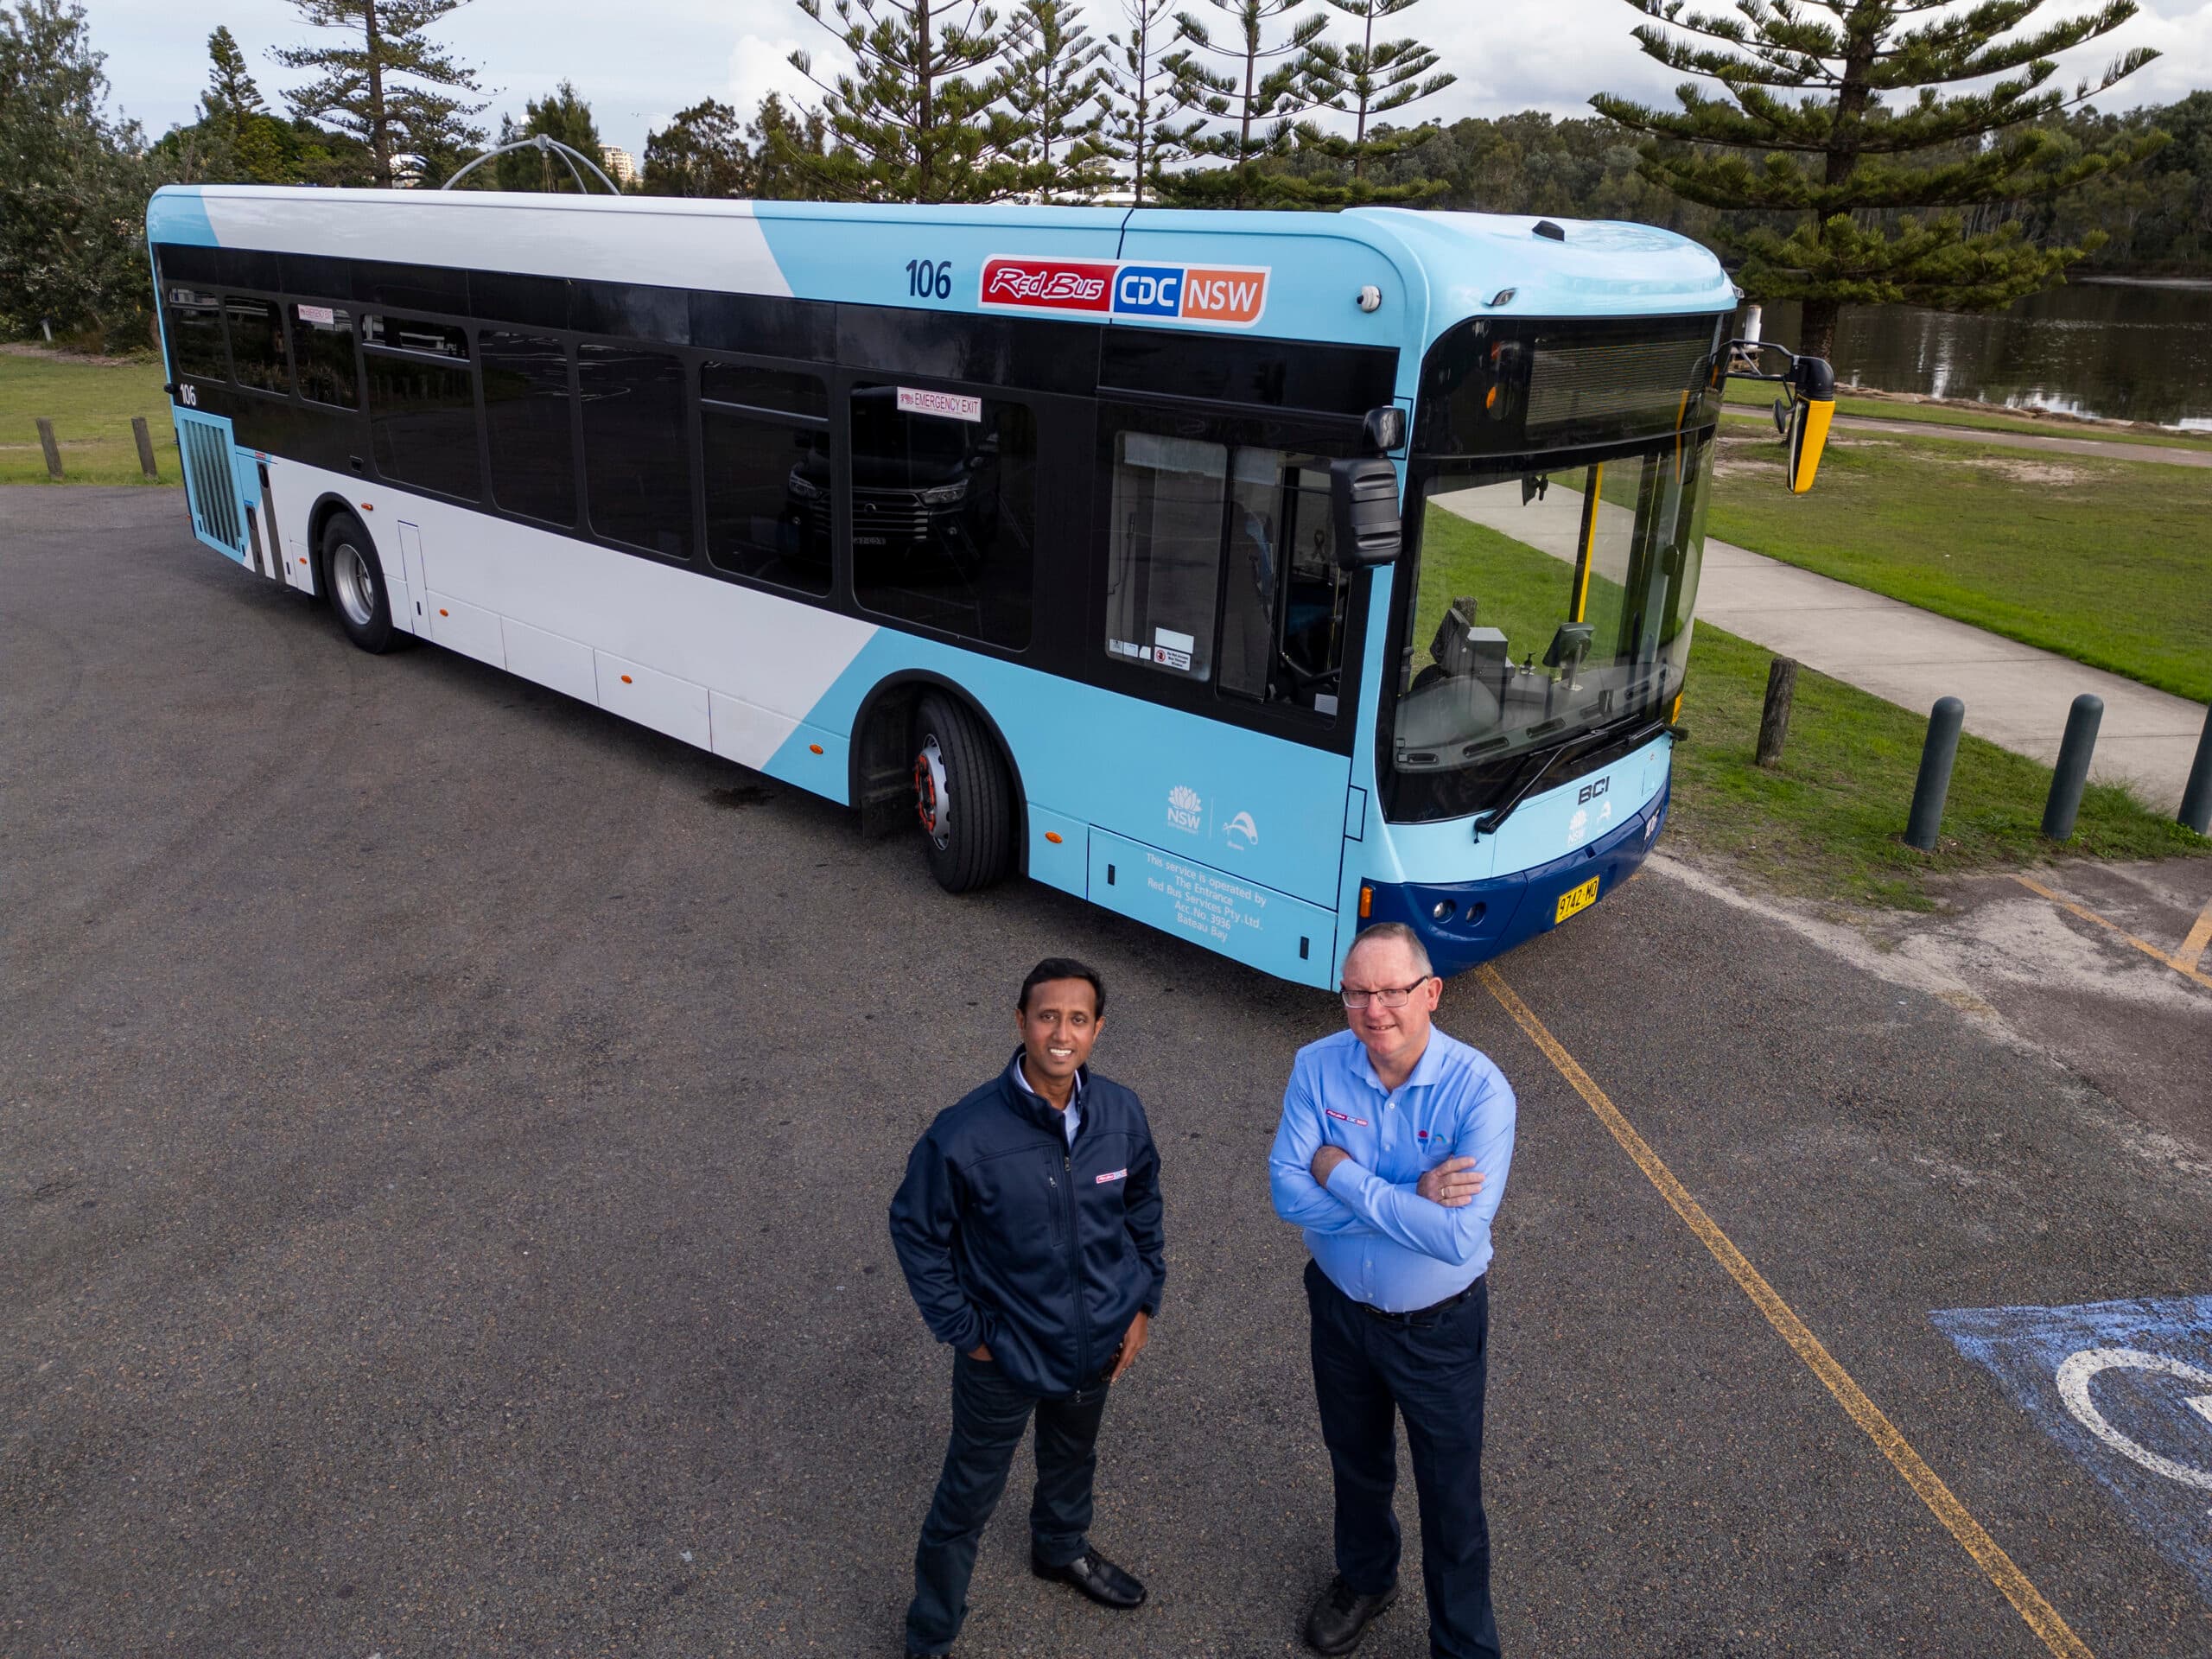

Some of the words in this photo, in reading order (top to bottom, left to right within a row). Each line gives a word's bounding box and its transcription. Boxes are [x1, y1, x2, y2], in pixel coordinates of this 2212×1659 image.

[906, 259, 951, 299] 106
[1122, 276, 1177, 307] CDC
[1188, 280, 1258, 312] NSW
[180, 383, 197, 406] 106
[914, 392, 961, 411] EMERGENCY
[962, 399, 978, 414] EXIT
[1578, 776, 1610, 805] BCI
[1167, 808, 1201, 830] NSW
[1147, 853, 1162, 867] This
[1166, 862, 1197, 880] service
[1199, 871, 1206, 883] is
[1209, 878, 1251, 899] operated
[1255, 892, 1267, 907] by
[1147, 878, 1164, 892] Red
[1167, 884, 1182, 899] Bus
[1185, 891, 1221, 913] Services
[1175, 875, 1192, 890] The
[1194, 883, 1234, 906] Entrance
[1177, 912, 1208, 932] Bateau
[1211, 925, 1228, 943] Bay
[1211, 913, 1230, 931] 3936
